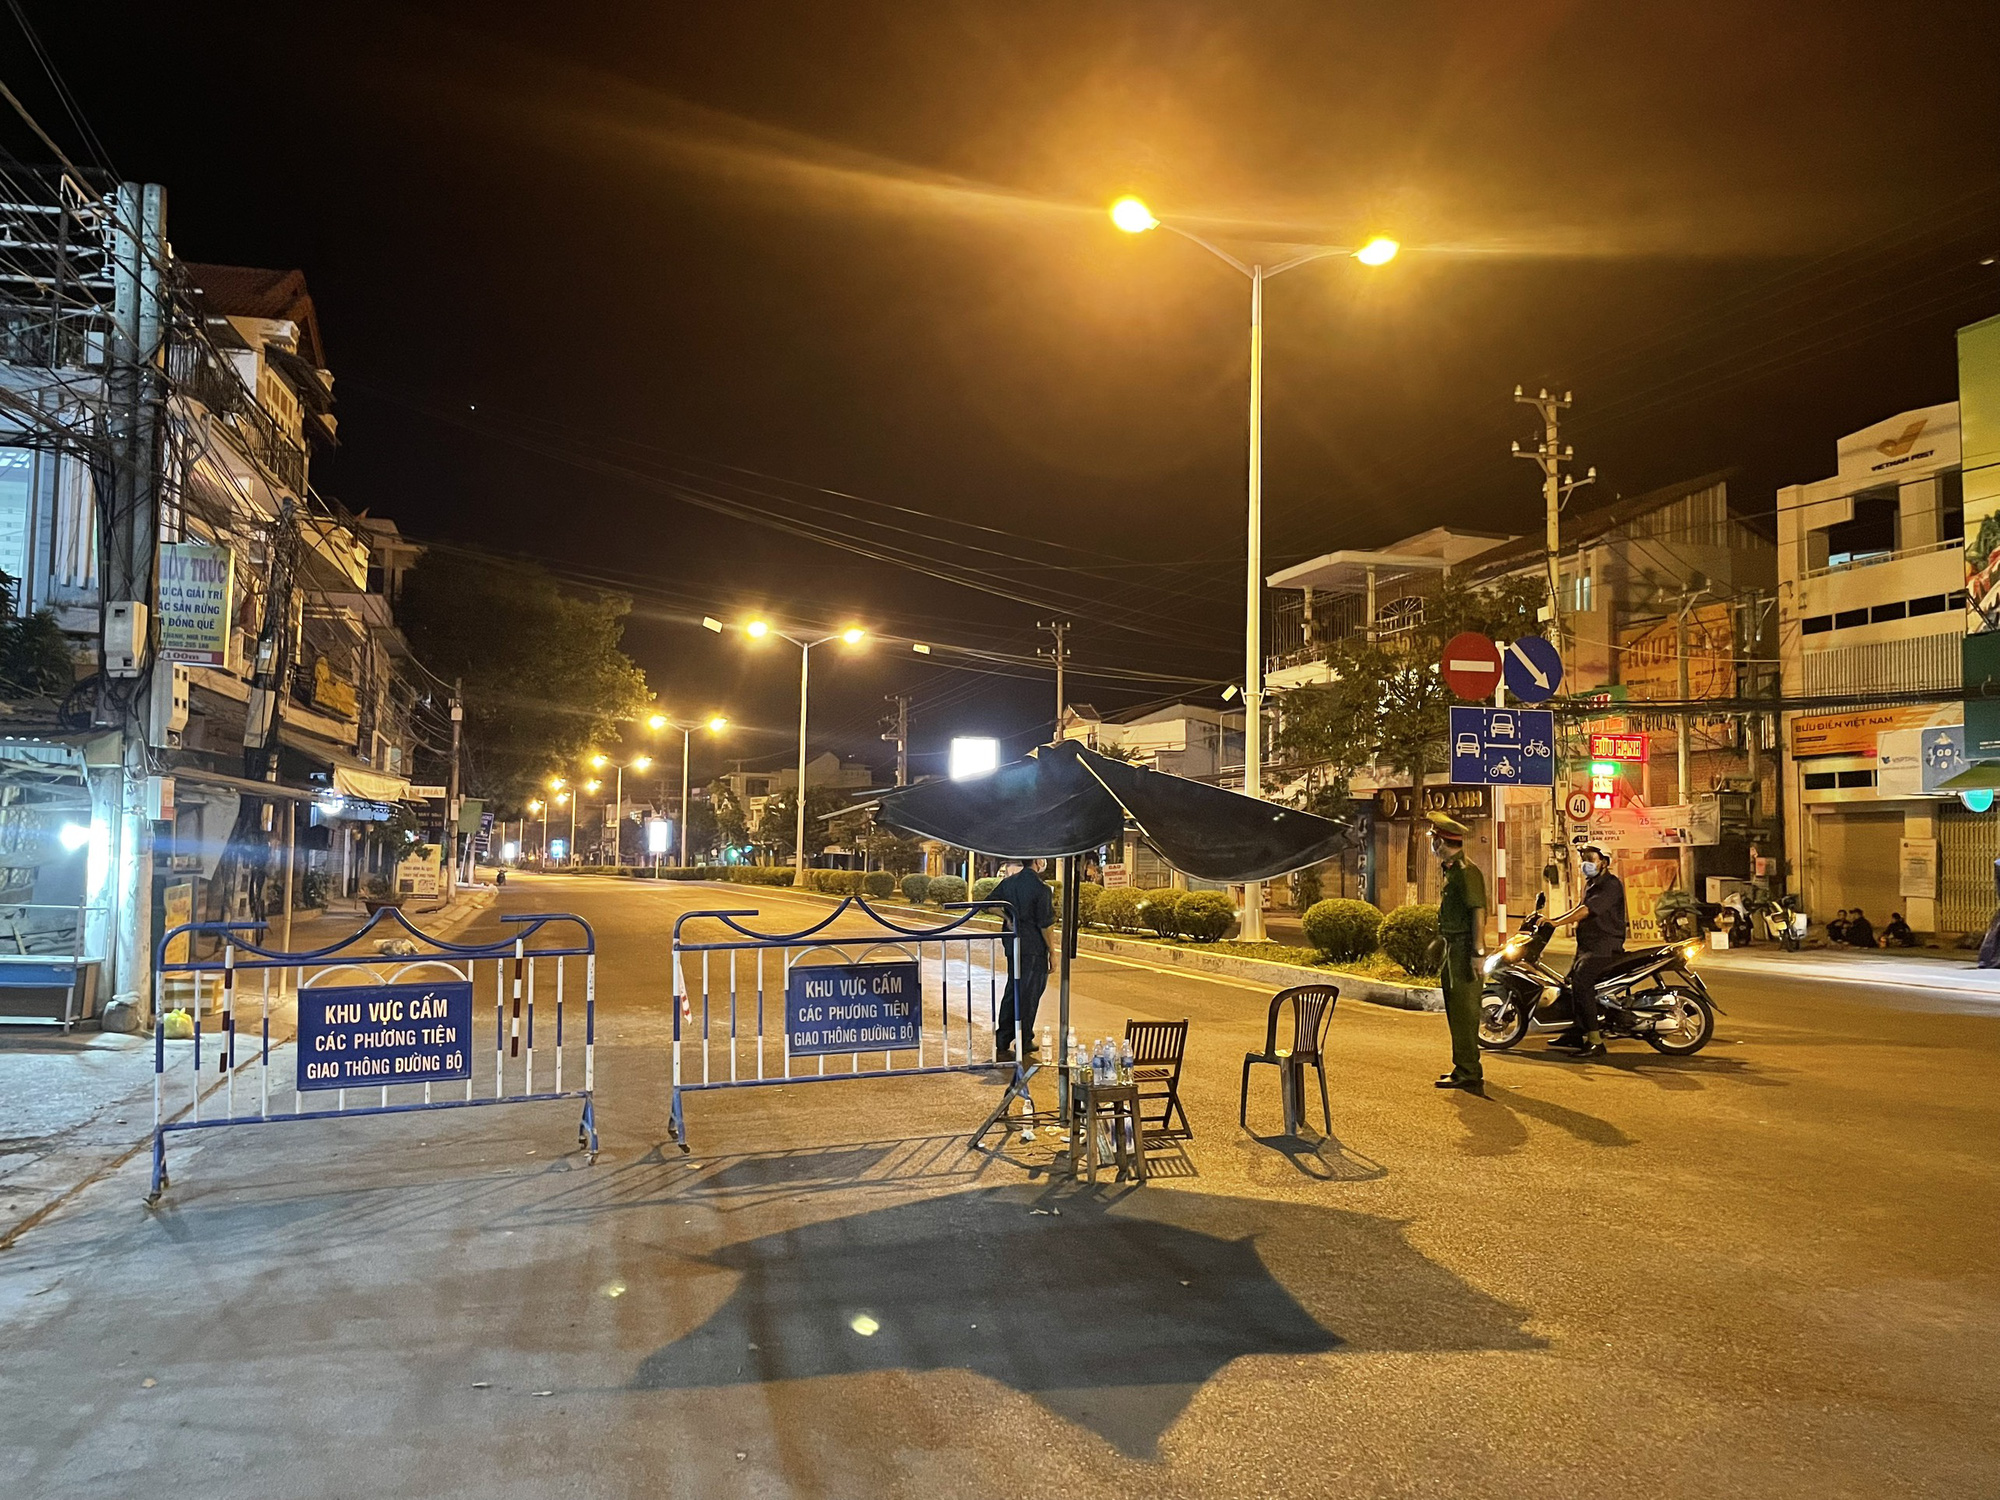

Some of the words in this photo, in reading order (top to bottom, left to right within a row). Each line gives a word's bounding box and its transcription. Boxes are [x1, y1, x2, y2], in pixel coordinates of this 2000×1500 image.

[207, 588, 223, 600] TRÍ
[197, 617, 215, 630] QUÊ
[165, 651, 200, 660] 100m
[1869, 716, 1894, 725] NAM
[1593, 737, 1614, 756] HỮU
[1615, 739, 1641, 759] HẠNH
[1446, 790, 1483, 808] ANH
[1573, 798, 1586, 814] 40
[1639, 817, 1650, 826] 25
[805, 980, 833, 998] KHU
[840, 976, 867, 999] VỰC
[872, 971, 902, 995] CẤM
[325, 1004, 361, 1024] KHU
[368, 999, 404, 1026] VỰC
[409, 992, 448, 1020] CẤM
[798, 1004, 823, 1022] CÁC
[829, 1002, 878, 1020] PHƯƠNG
[883, 999, 909, 1019] TIỆN
[315, 1031, 347, 1052] CÁC
[354, 1028, 416, 1049] PHƯƠNG
[422, 1024, 456, 1047] TIỆN
[794, 1030, 819, 1046] GIAO
[822, 1025, 857, 1044] THÔNG
[860, 1023, 896, 1042] ĐƯỜNG
[900, 1022, 914, 1041] BỘ
[307, 1061, 339, 1079] GIAO
[345, 1056, 390, 1077] THÔNG
[395, 1051, 440, 1073] ĐƯỜNG
[446, 1049, 463, 1073] BỘ
